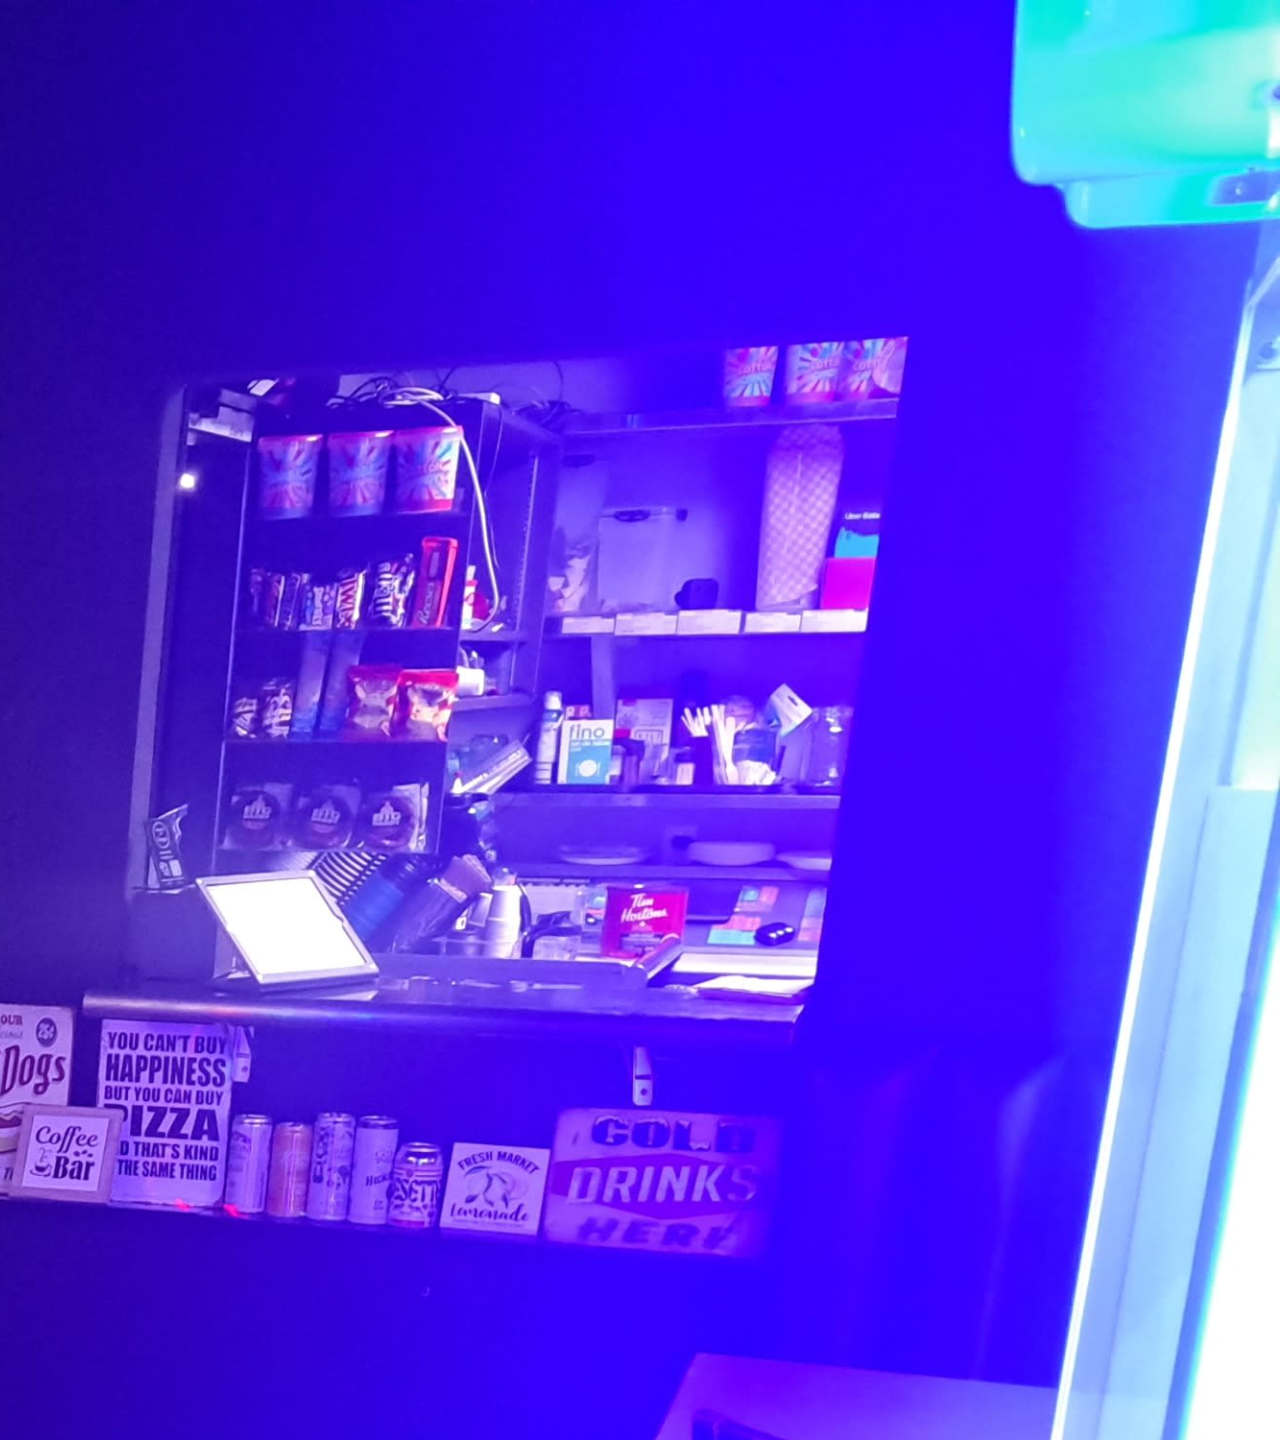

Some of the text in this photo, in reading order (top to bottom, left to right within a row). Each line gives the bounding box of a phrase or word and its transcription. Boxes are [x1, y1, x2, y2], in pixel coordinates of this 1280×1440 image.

[0, 1015, 24, 1026] OUR
[107, 1031, 228, 1056] YOU CAN'T BUY
[104, 1053, 228, 1088] HAPPINESS
[104, 1085, 225, 1107] BUT YOU CAN BUY
[34, 1124, 99, 1155] Coffee
[590, 1115, 757, 1151] COLD
[133, 1142, 181, 1160] THAT'S
[183, 1144, 220, 1162] KIND
[456, 1150, 541, 1175] FRESH MARKET
[52, 1155, 96, 1182] Bar
[117, 1159, 218, 1182] THE SAME THING
[567, 1163, 761, 1205] DRINKS
[450, 1202, 530, 1223] Lemonade
